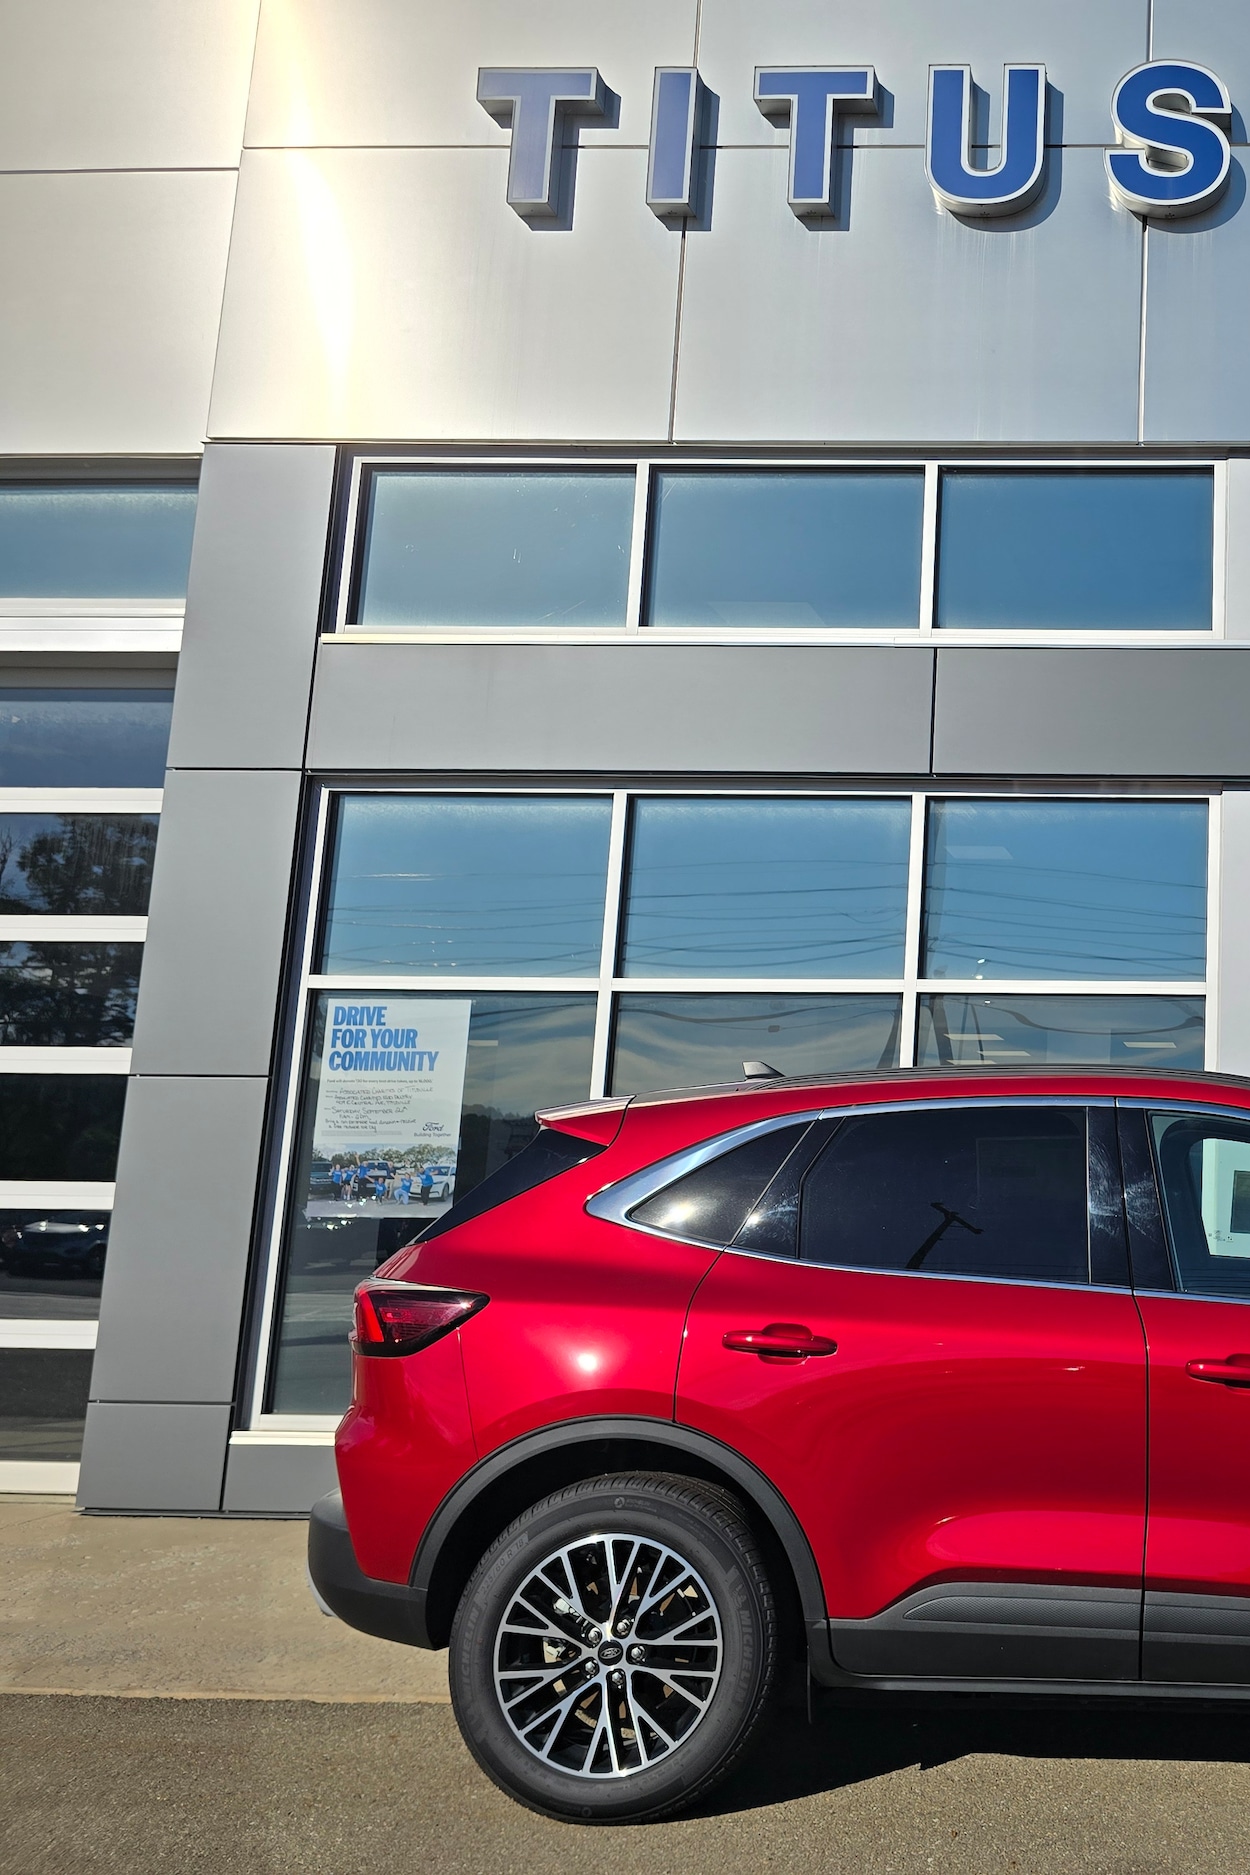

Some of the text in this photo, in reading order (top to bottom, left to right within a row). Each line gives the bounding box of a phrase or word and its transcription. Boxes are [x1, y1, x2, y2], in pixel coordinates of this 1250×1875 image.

[333, 1006, 387, 1026] DRIVE
[331, 1028, 418, 1049] FOR YOUR
[328, 1050, 439, 1072] COMMUNITY
[423, 1122, 444, 1131] Ford
[735, 1610, 754, 1705] MICHELIN
